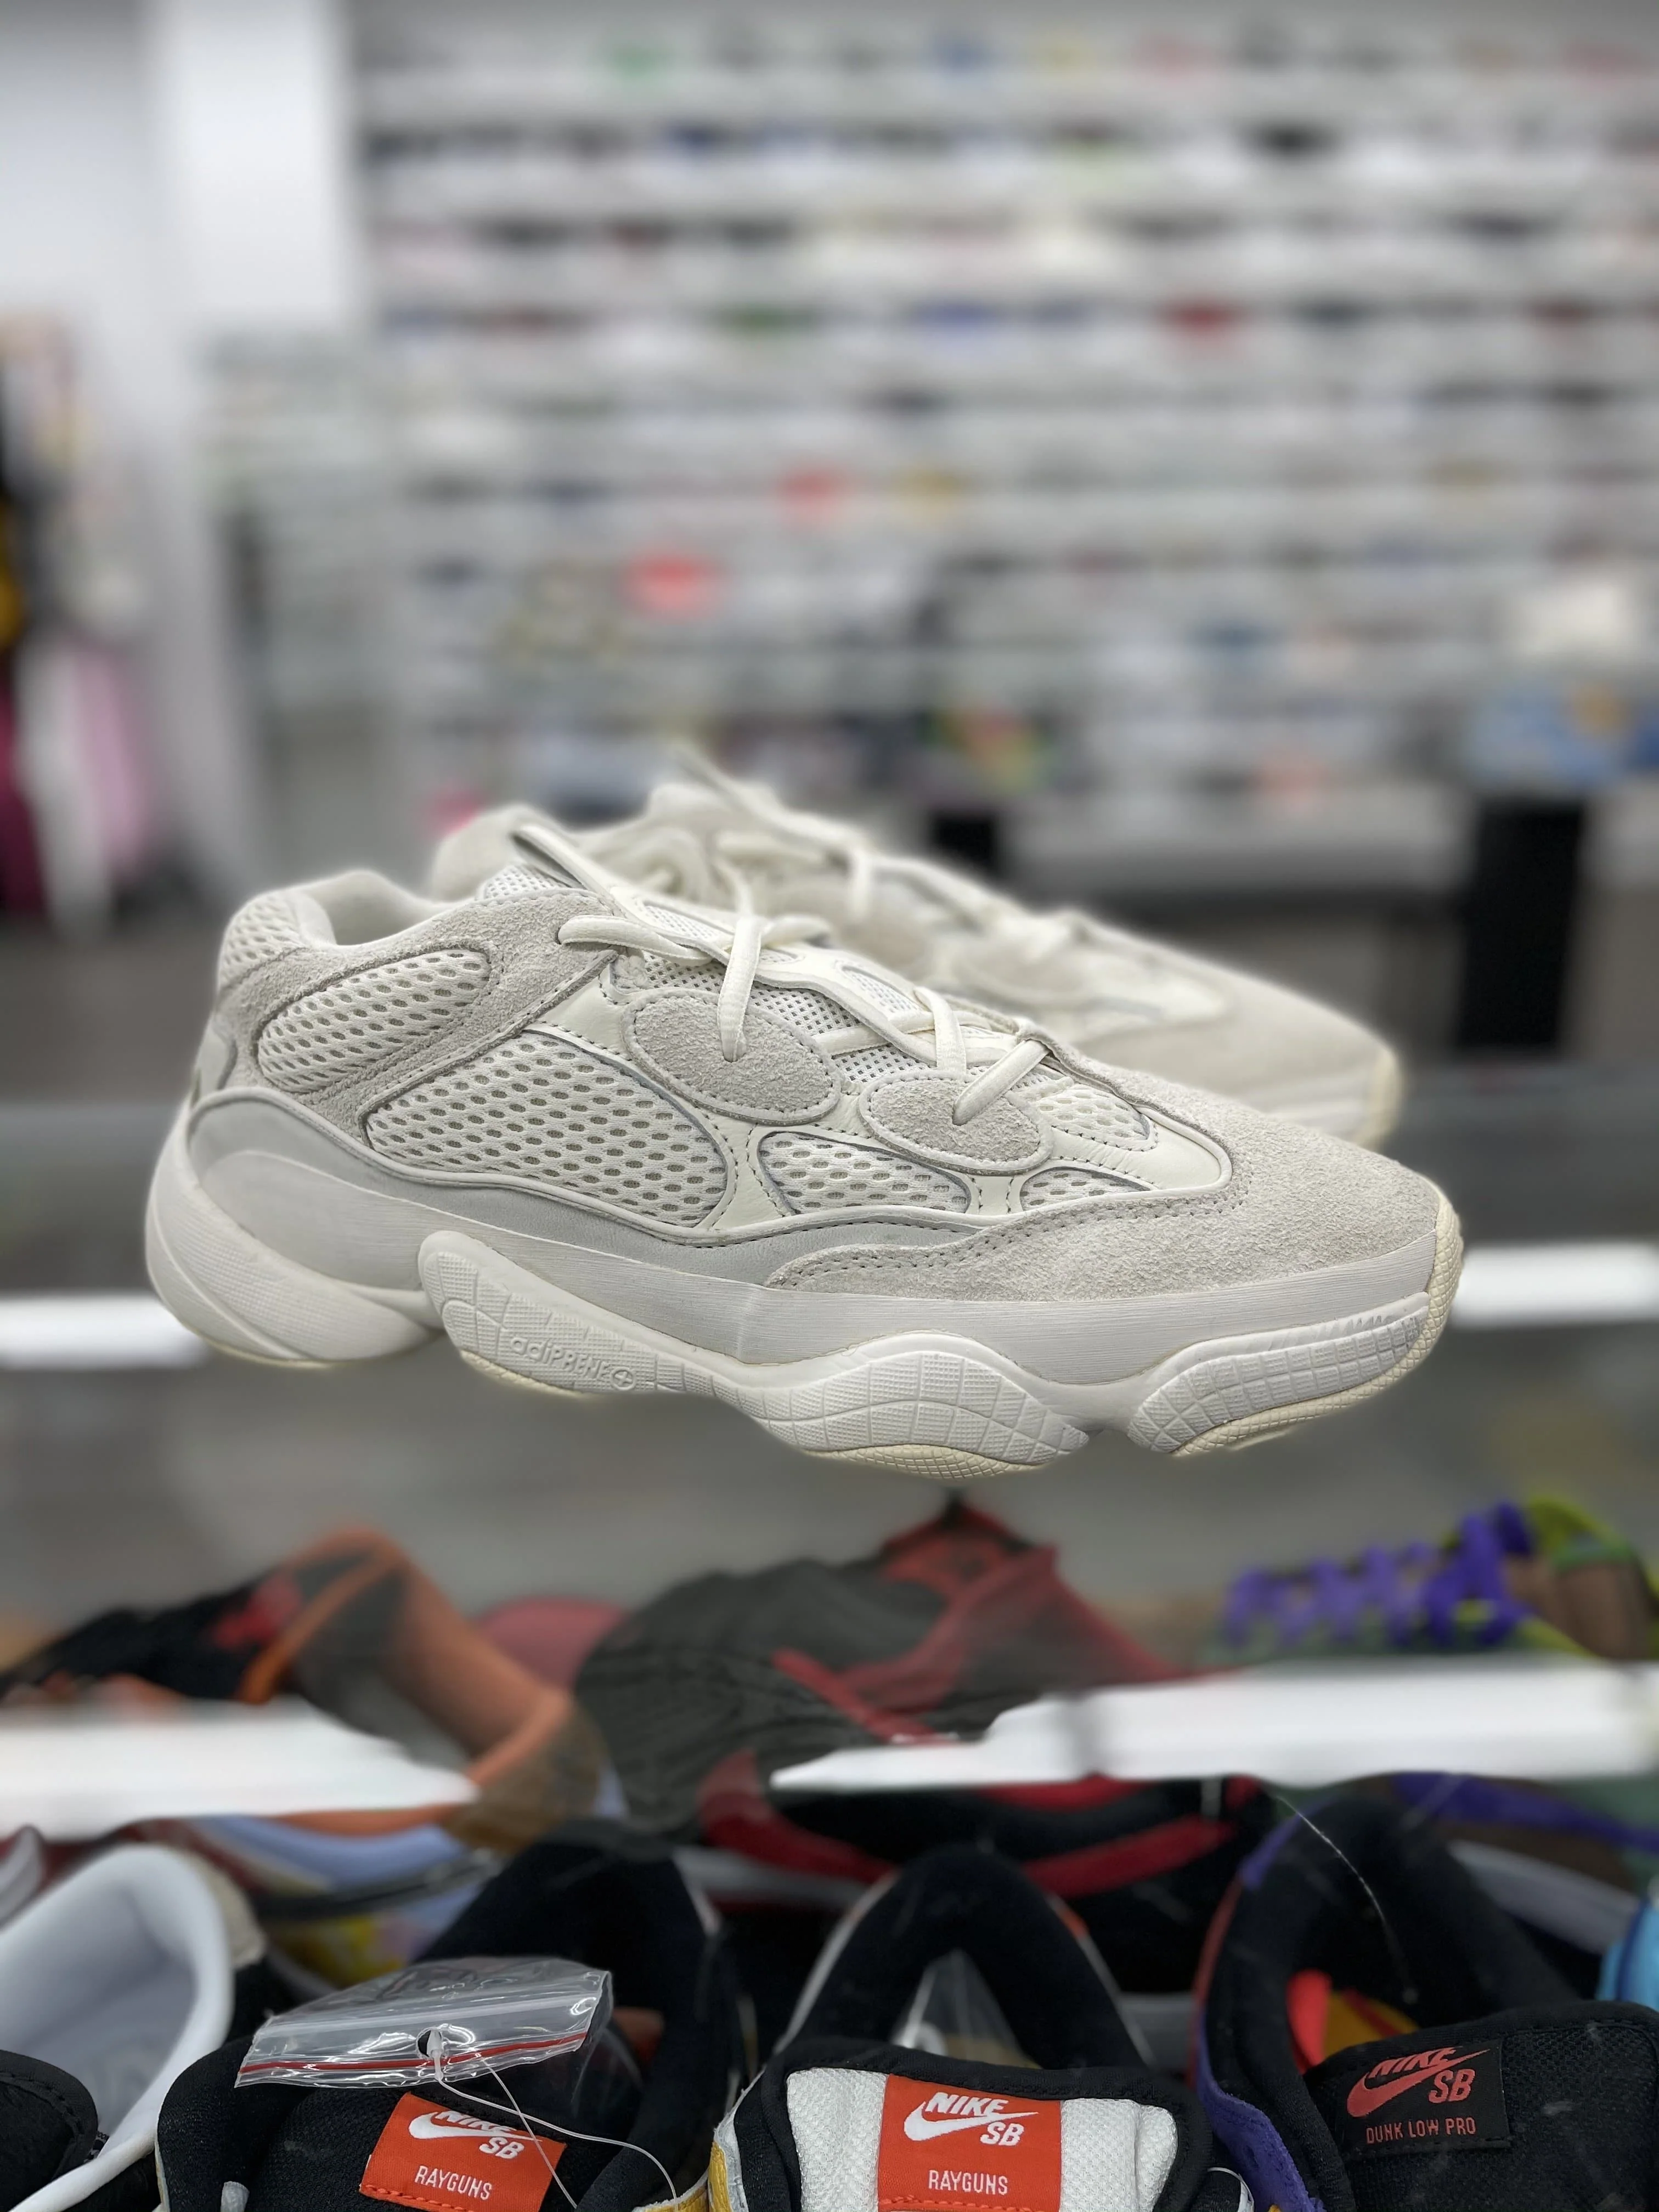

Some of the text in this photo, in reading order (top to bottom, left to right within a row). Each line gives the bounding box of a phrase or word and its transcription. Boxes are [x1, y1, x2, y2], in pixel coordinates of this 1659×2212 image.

[1369, 2046, 1462, 2078] NIKE
[1429, 2069, 1476, 2103] SB
[925, 2092, 1009, 2117] NIKE
[435, 2111, 517, 2132] NIKE
[980, 2121, 1024, 2146] SB
[1366, 2117, 1476, 2145] DUNK LOW PRO
[479, 2137, 524, 2159] SB
[415, 2165, 493, 2200] RAYGUNS
[928, 2170, 1008, 2196] RAYGUNS
